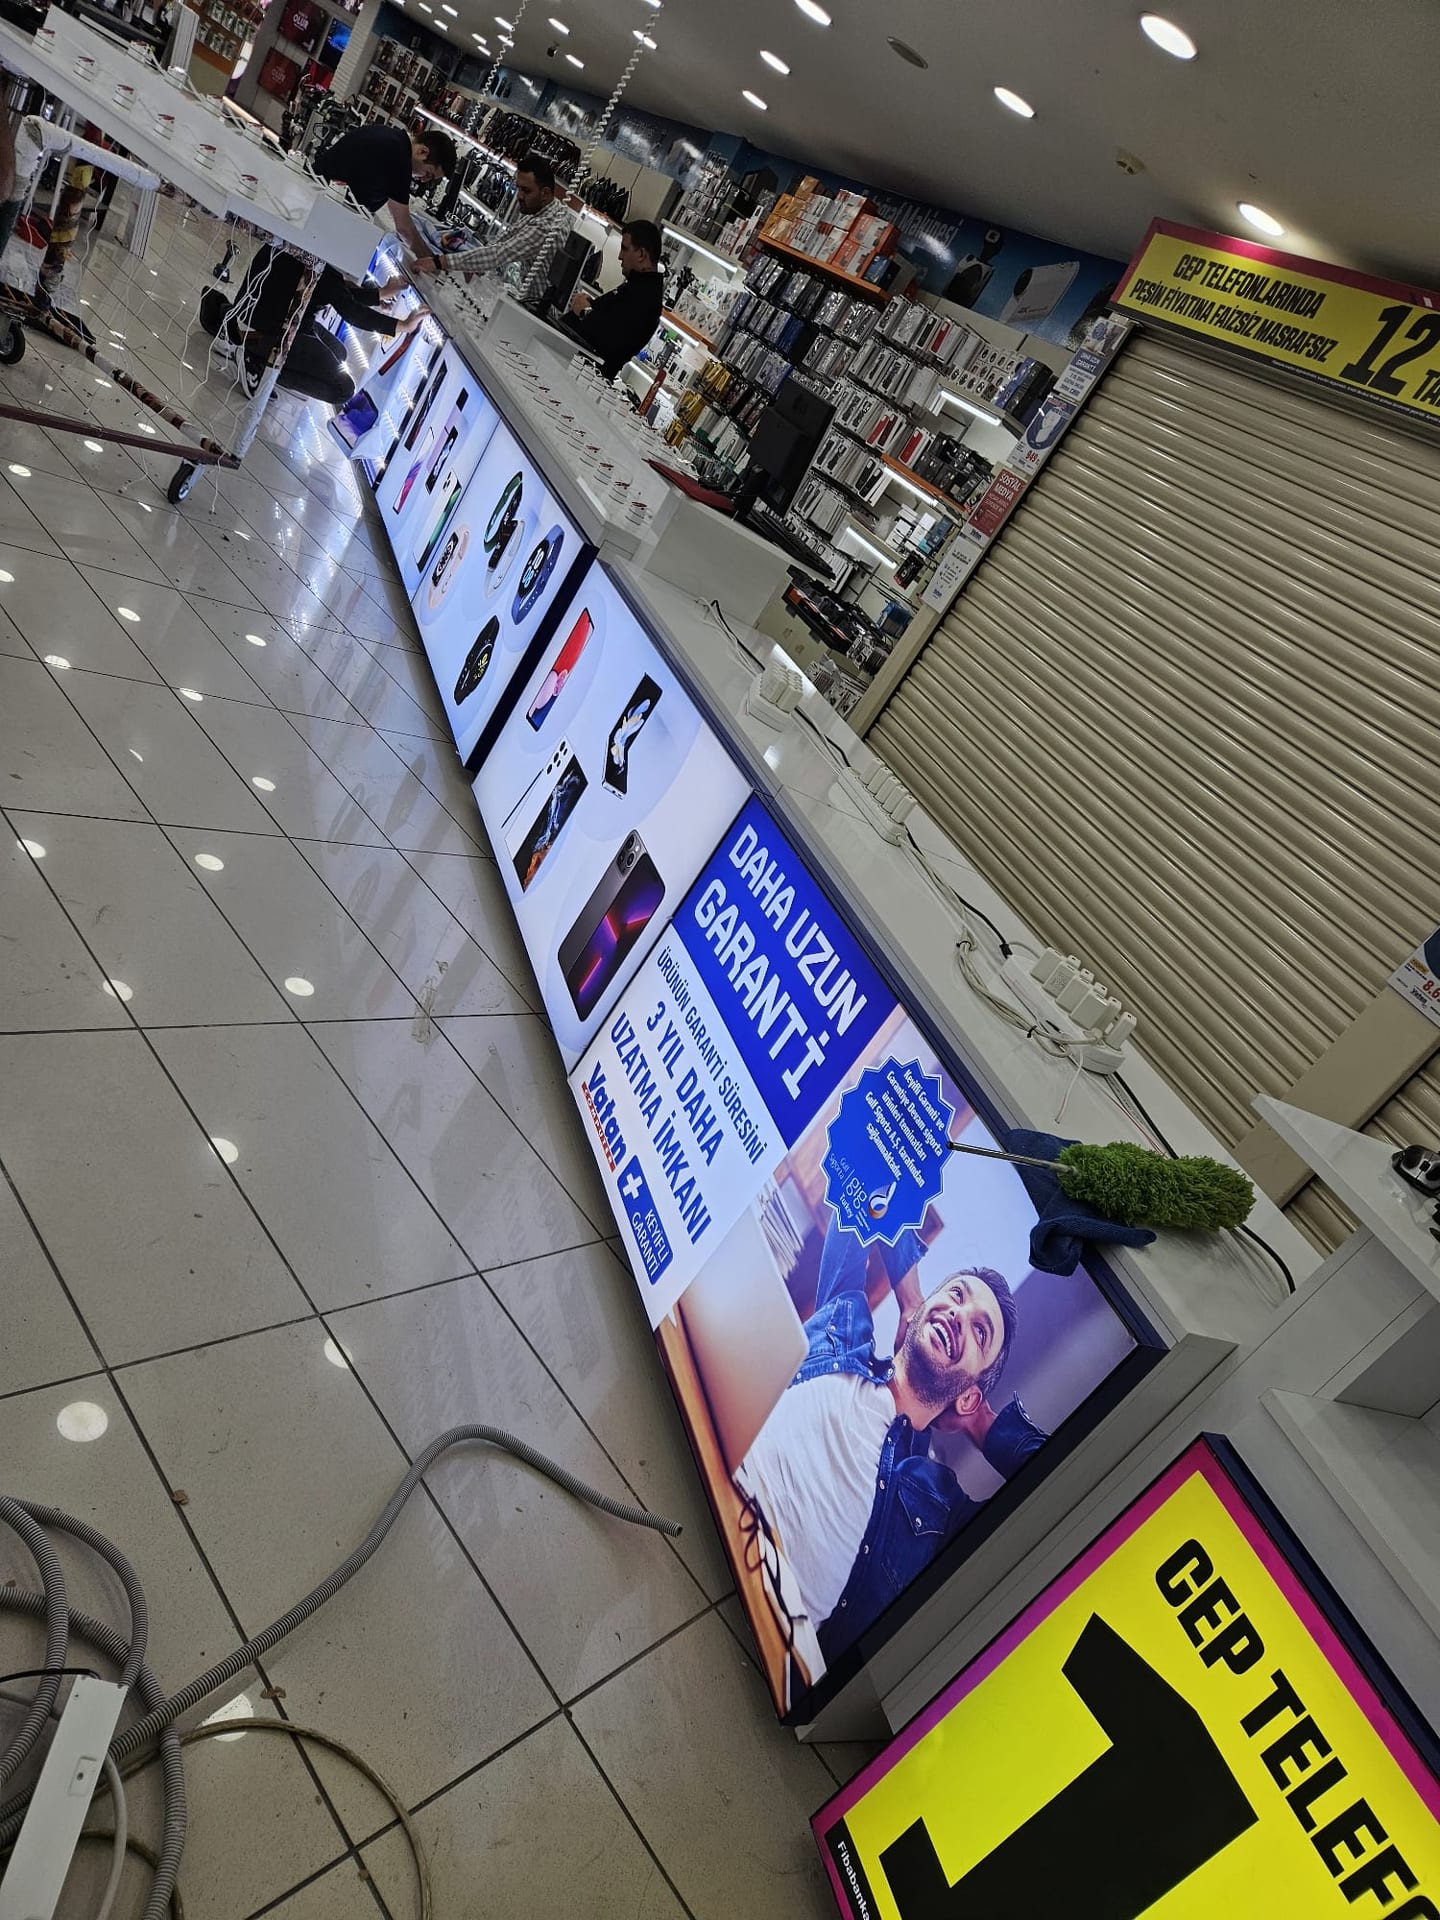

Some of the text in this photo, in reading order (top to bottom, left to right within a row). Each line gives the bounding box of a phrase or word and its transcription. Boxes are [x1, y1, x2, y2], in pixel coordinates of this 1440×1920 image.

[1129, 278, 1338, 363] PEŞİN FİYATINA FAİZSİZ MASRAFSIZ
[1173, 254, 1327, 319] CEP TELEFONLARINDA
[1338, 304, 1440, 396] 12
[995, 483, 1014, 502] MEDYA
[999, 473, 1021, 492] SOSYAL
[729, 823, 868, 1038] DAHA UZUN
[693, 878, 831, 1101] GARANTİ
[646, 1000, 726, 1168] 3 YIL DAHA
[657, 944, 769, 1166] ÜRÜNÜN GARANTİ SÜRESİNİ
[588, 1060, 627, 1167] Vatan
[610, 1012, 712, 1245] UZATMA İMKANI
[881, 1090, 902, 1122] ürünleri
[886, 1071, 943, 1157] Garantiye Devam sigorta
[903, 1069, 945, 1132] Keyifli Garanti ve
[872, 1107, 892, 1136] Sigorta
[898, 1145, 926, 1188] tarafından
[840, 1194, 853, 1219] Turkey
[845, 1177, 868, 1210] gig
[632, 1211, 660, 1277] GARANTİ
[1154, 1538, 1266, 1676] CEP
[879, 1612, 1259, 1920] 1
